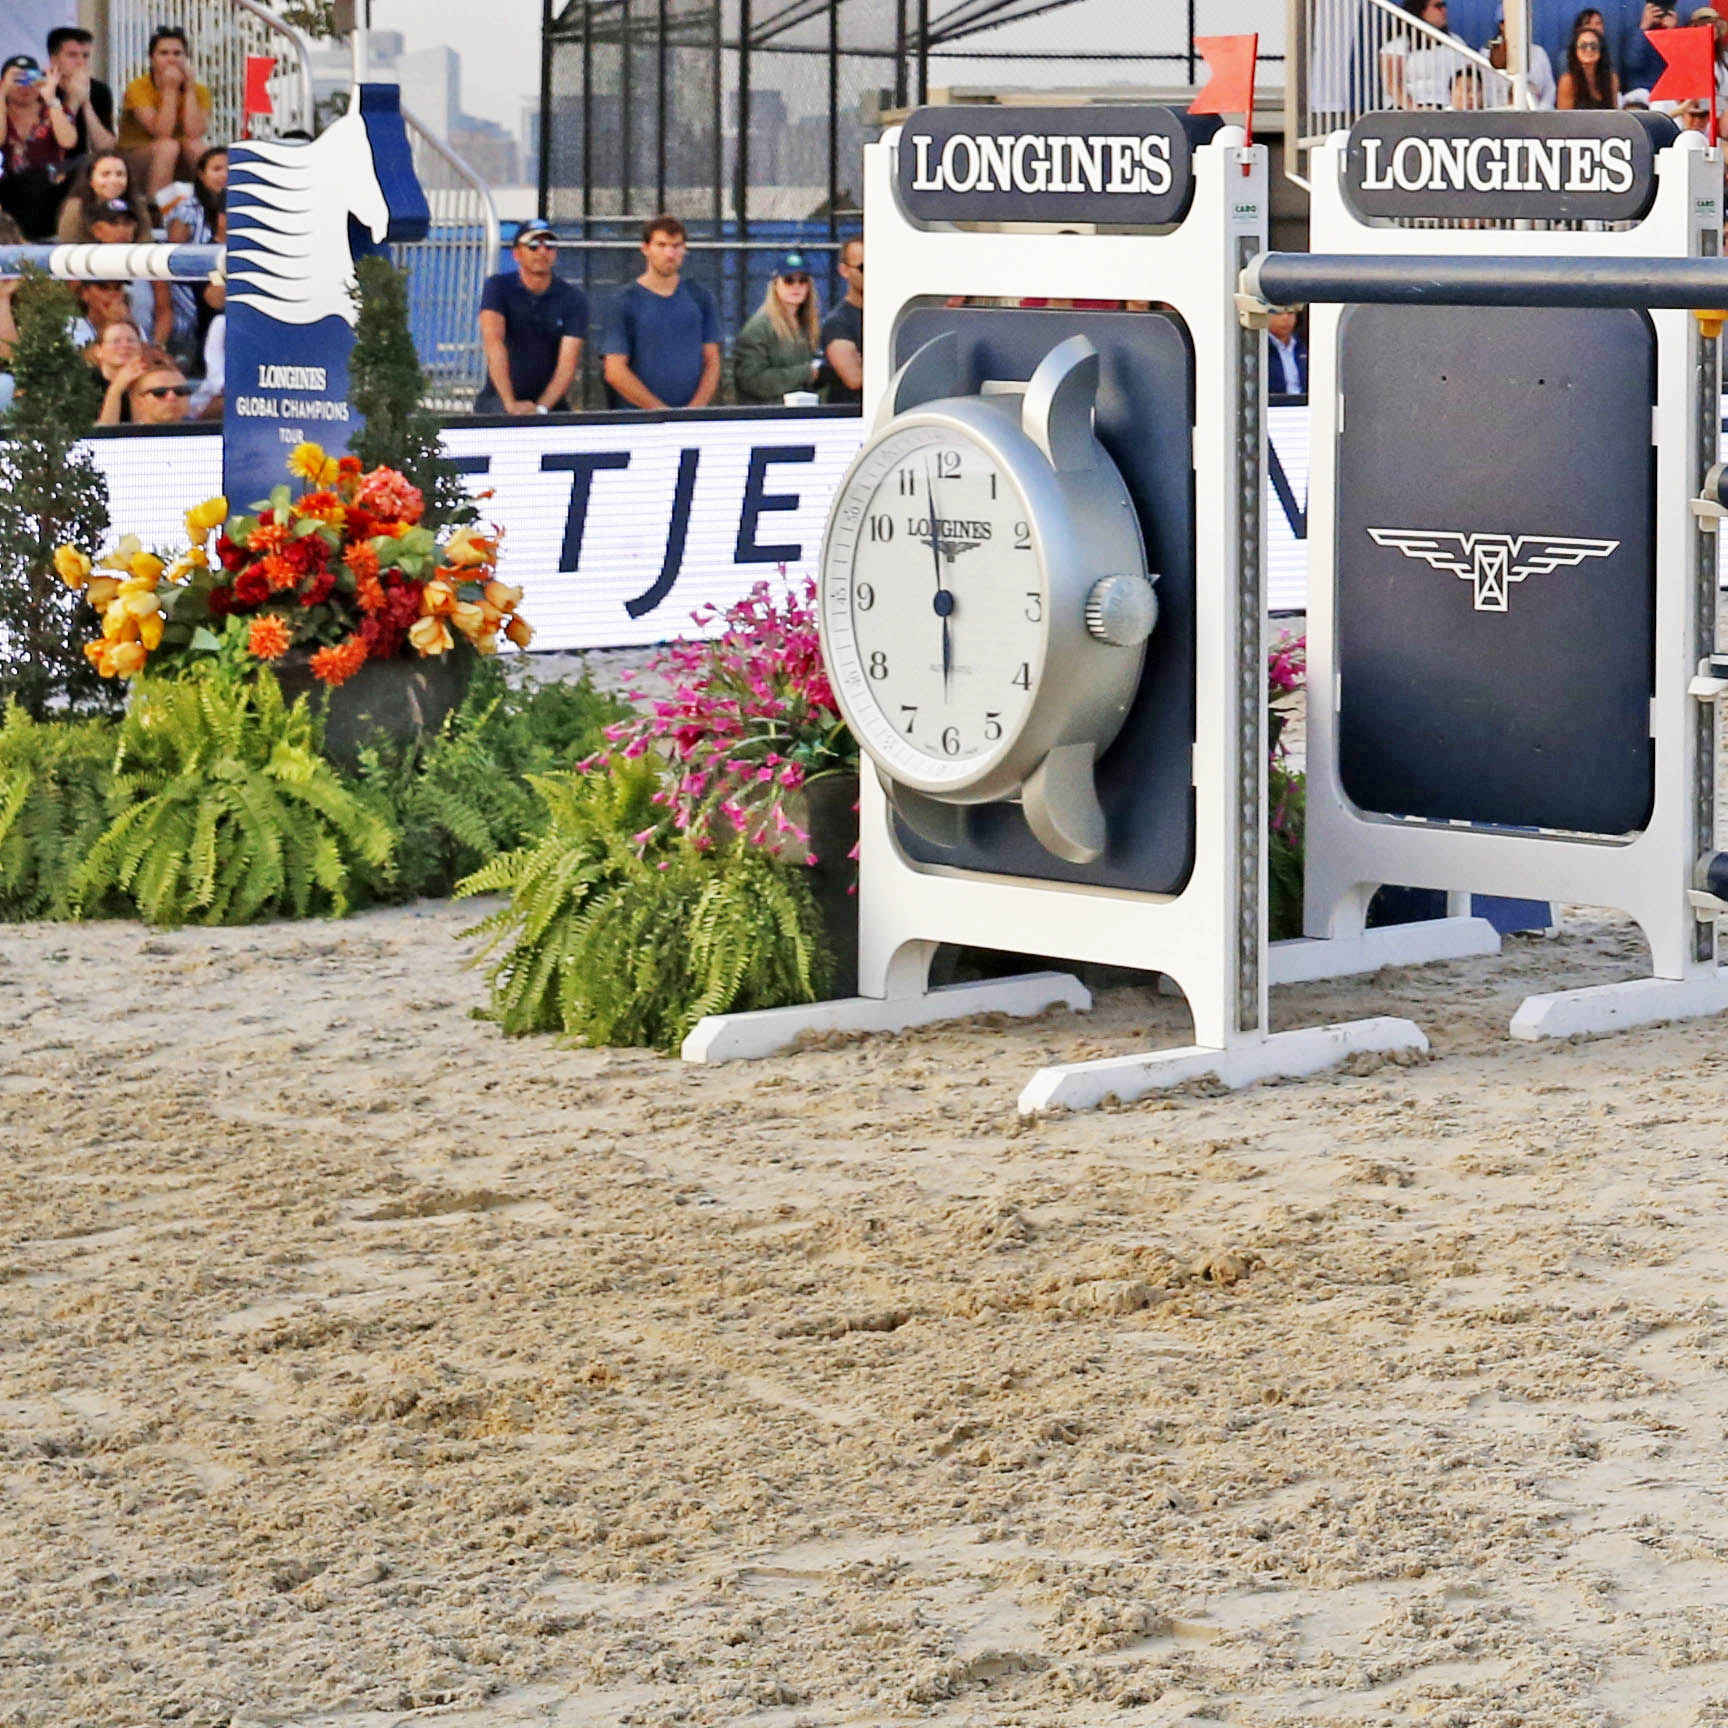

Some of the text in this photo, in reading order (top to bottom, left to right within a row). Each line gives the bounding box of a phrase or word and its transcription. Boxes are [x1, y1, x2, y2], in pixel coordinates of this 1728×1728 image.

[911, 133, 1172, 196] LONGINES
[1359, 137, 1634, 194] LONGINES
[258, 364, 326, 390] LONGINES
[236, 396, 350, 422] GLOBAL CHAMPIONS
[936, 451, 962, 479] 12
[900, 468, 915, 496] 11
[988, 474, 998, 500] 1
[870, 514, 894, 542] 10
[1014, 522, 1032, 550] 2
[857, 583, 874, 612] 9
[1025, 592, 1042, 622] 3
[870, 651, 888, 680] 8
[1012, 663, 1032, 691] 4
[901, 705, 918, 734] 7
[984, 712, 1002, 741] 5
[942, 727, 960, 756] 6
